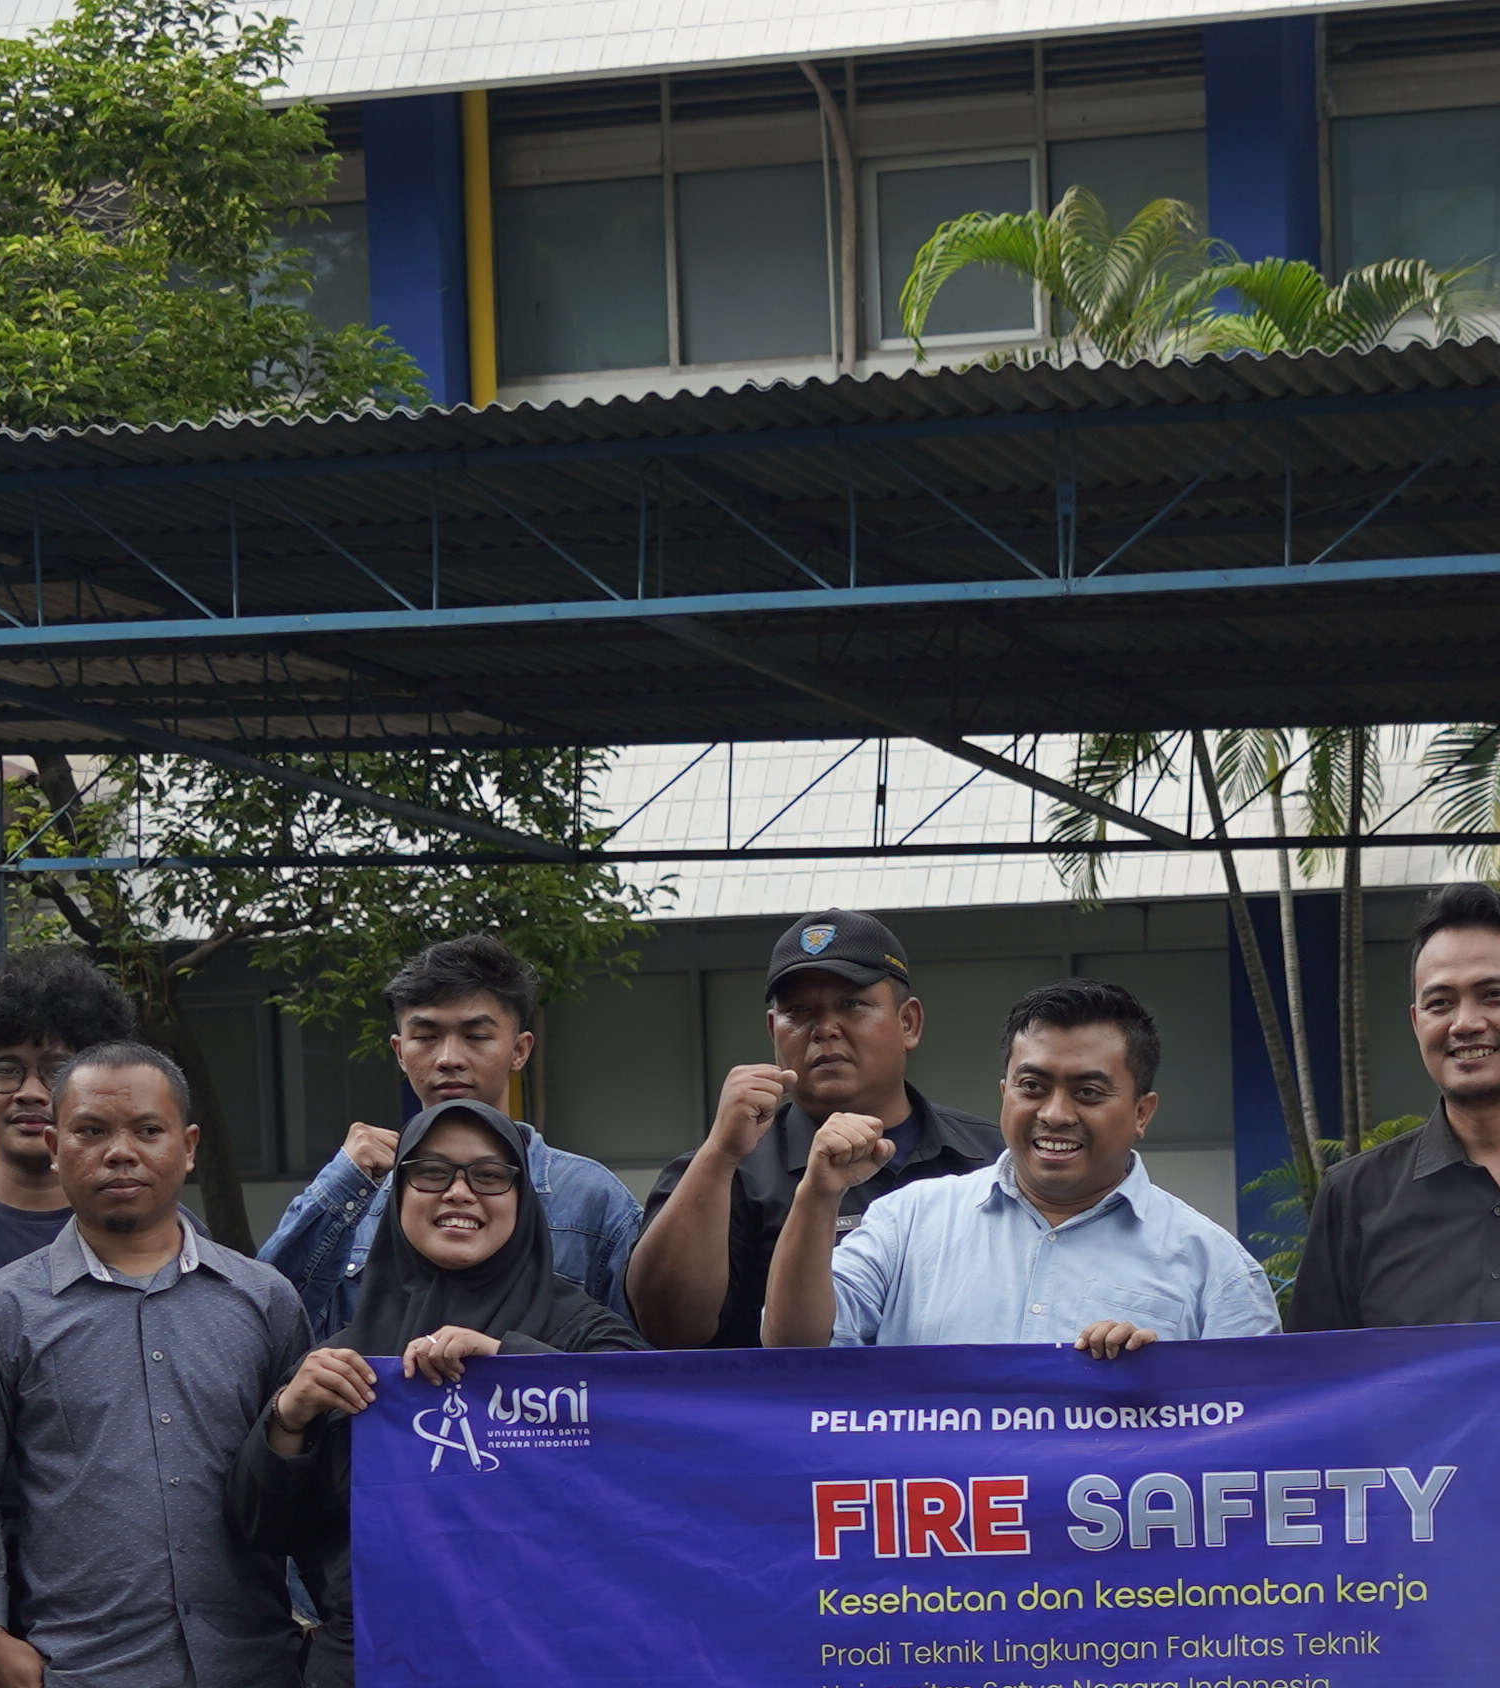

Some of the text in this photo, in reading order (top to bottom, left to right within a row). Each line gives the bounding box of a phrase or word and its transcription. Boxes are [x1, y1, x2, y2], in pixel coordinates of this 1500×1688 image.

[810, 1401, 1245, 1433] PELATIHAN DAN WORKSHOP
[811, 1465, 1459, 1561] FIRE SAFETY
[819, 1572, 1428, 1616] Kesehatan dan keselamatan kerja
[821, 1630, 1381, 1670] Prodi Teknik Lingkungan Fakultas Teknik
